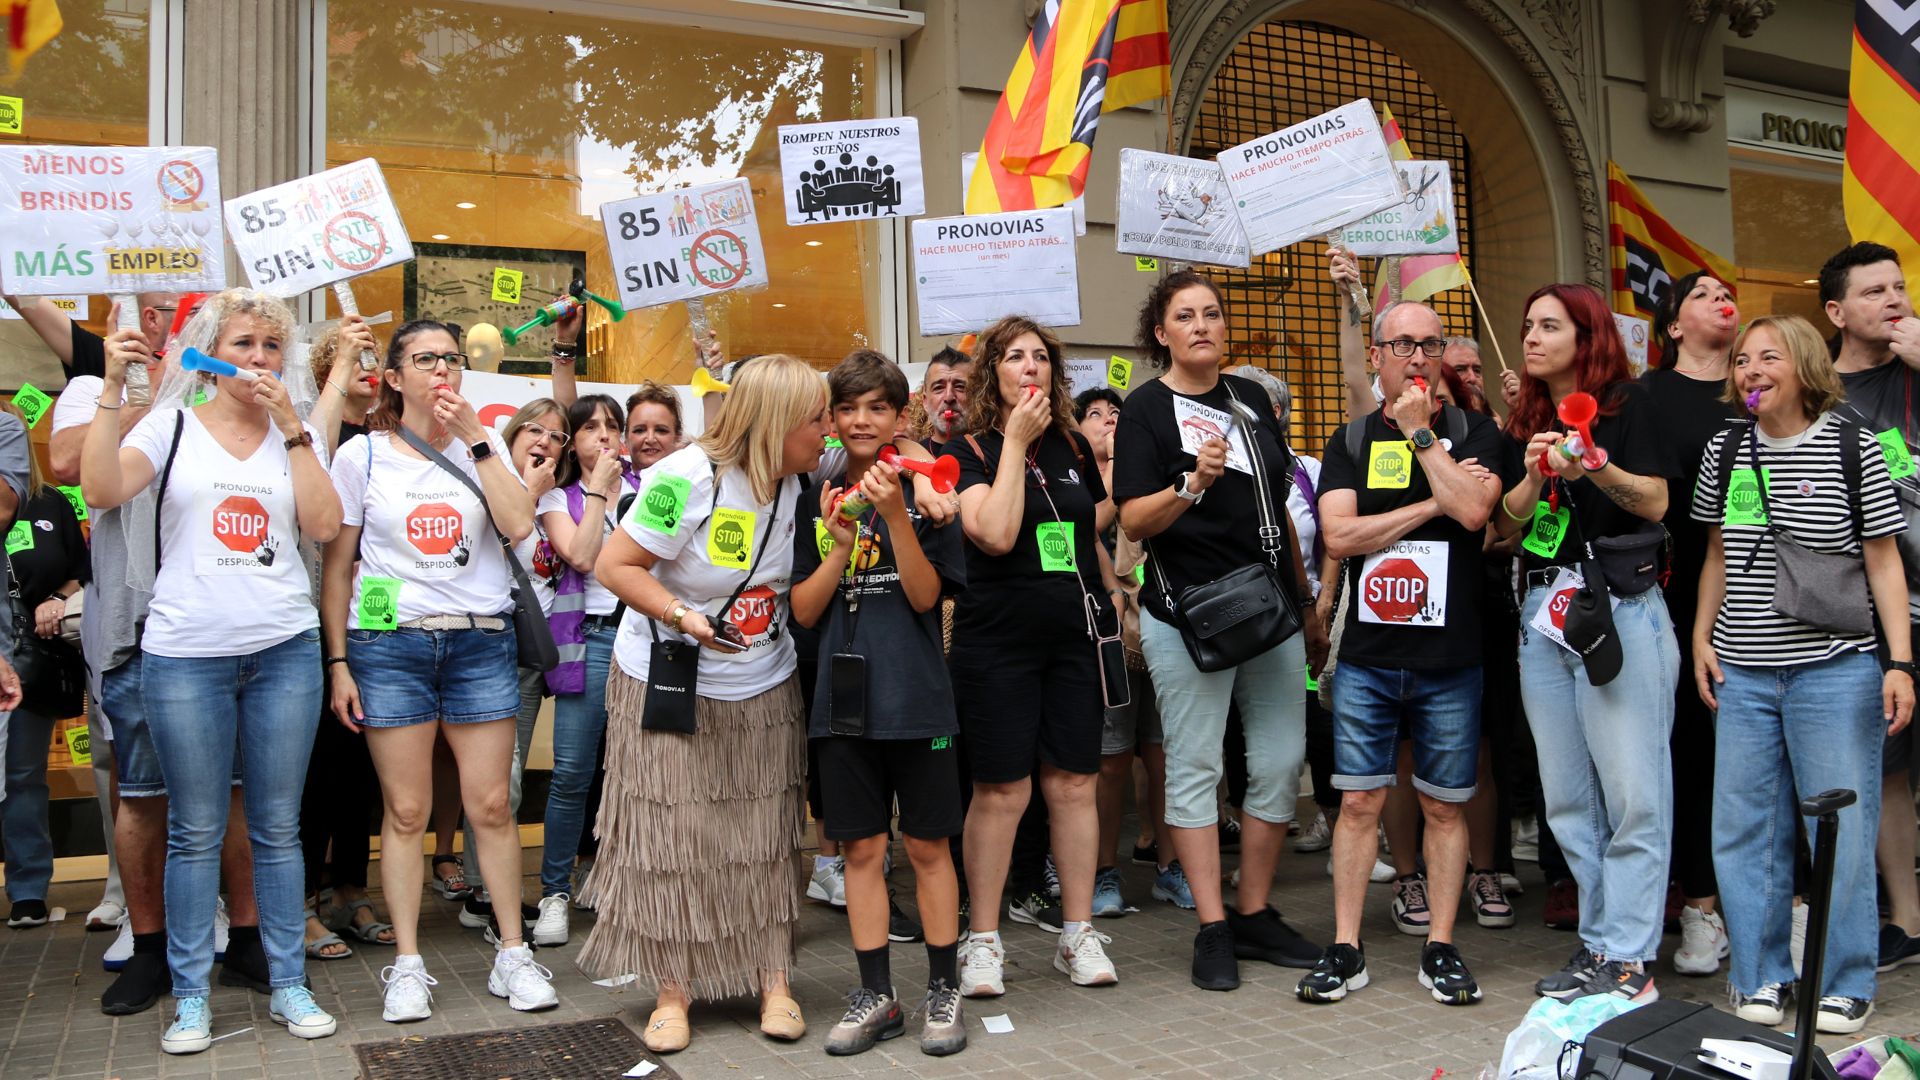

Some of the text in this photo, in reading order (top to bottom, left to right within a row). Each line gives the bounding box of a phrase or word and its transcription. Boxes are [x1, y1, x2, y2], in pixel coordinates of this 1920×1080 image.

[782, 126, 900, 144] ROMPEN NUESTROS
[1243, 115, 1346, 163] PRONOVIAS
[812, 141, 860, 156] SUEÑOS
[23, 155, 125, 175] MENOS
[1231, 167, 1256, 182] HACE
[1258, 153, 1295, 173] MUCHO
[1296, 139, 1333, 159] TIEMPO
[20, 191, 134, 211] BRINDIS
[240, 198, 287, 234] 85
[618, 207, 661, 241] 85
[938, 218, 1044, 240] PRONOVIAS
[680, 236, 748, 262] BROTES
[919, 244, 946, 256] HACE
[947, 242, 986, 254] MUCHO
[988, 240, 1026, 250] TIEMPO
[15, 243, 199, 277] MÁS EMPLEO
[254, 245, 316, 285] SIN
[624, 258, 680, 293] SIN
[686, 262, 753, 287] VERDES
[498, 280, 514, 289] STOP
[1112, 367, 1126, 377] STOP
[20, 396, 39, 412] STOP
[1180, 400, 1229, 424] PRONOVIAS
[1375, 458, 1402, 470] STOP
[214, 482, 273, 495] PRONOVIAS
[406, 490, 460, 500] PRONOVIAS
[1733, 490, 1759, 503] STOP
[647, 490, 675, 509] STOP
[217, 511, 265, 537] STOP
[410, 516, 459, 540] STOP
[1537, 521, 1559, 537] STOP
[716, 529, 743, 545] STOP
[1045, 540, 1067, 551] STOP
[217, 558, 261, 567] DESPIDOS
[415, 561, 457, 569] DESPIDOS
[1368, 577, 1424, 604] STOP
[365, 595, 388, 608] STOP
[734, 597, 770, 620] STOP
[654, 684, 685, 692] PRONOVIAS
